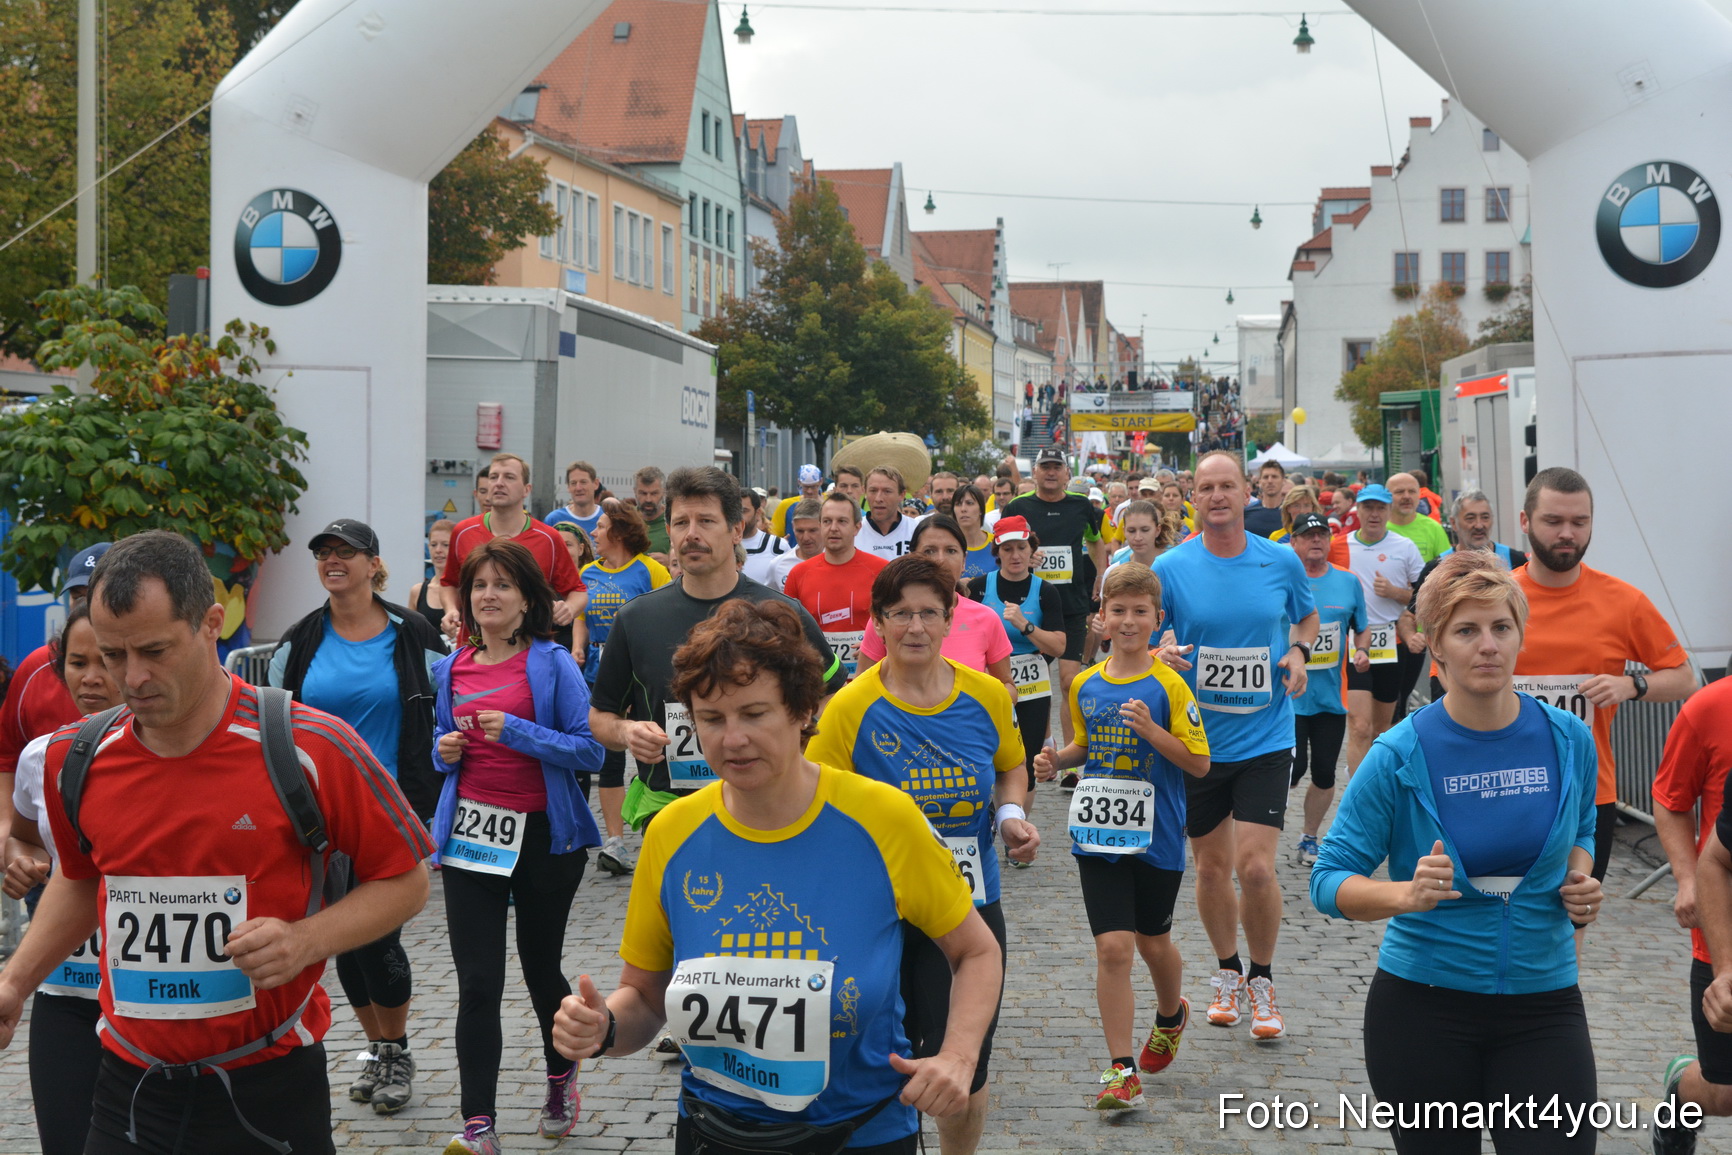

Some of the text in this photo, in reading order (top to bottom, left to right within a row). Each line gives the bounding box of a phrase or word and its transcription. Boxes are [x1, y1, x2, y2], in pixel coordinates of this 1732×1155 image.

[1605, 164, 1713, 208] BMW
[241, 190, 334, 231] BMW
[1111, 416, 1154, 427] START
[1041, 556, 1066, 570] 296
[1314, 634, 1333, 652] 25
[1370, 632, 1387, 648] 28
[1200, 653, 1259, 662] PARTL Neumarkt
[1011, 663, 1040, 684] 243
[1205, 663, 1265, 689] 2210
[1512, 683, 1579, 691] ARTL Neumarkt
[1214, 694, 1254, 705] Manfred
[1188, 729, 1206, 739] PARTL
[1448, 768, 1546, 792] SPORTWEISS
[915, 789, 980, 802] September 2014
[1076, 785, 1141, 796] PARTL Neumarkt
[1481, 784, 1550, 799] Wir sind Sport.
[1077, 796, 1146, 827] 3334
[453, 806, 517, 846] 2249
[454, 844, 499, 864] Manuela
[698, 876, 709, 884] 15
[109, 889, 218, 904] PARTL Neumarkt
[691, 887, 715, 896] Jahre
[118, 911, 232, 964] 2470
[148, 978, 202, 999] Frank
[673, 971, 801, 989] PARTL Neumarkt
[682, 993, 806, 1053] 2471
[722, 1052, 780, 1089] Marion
